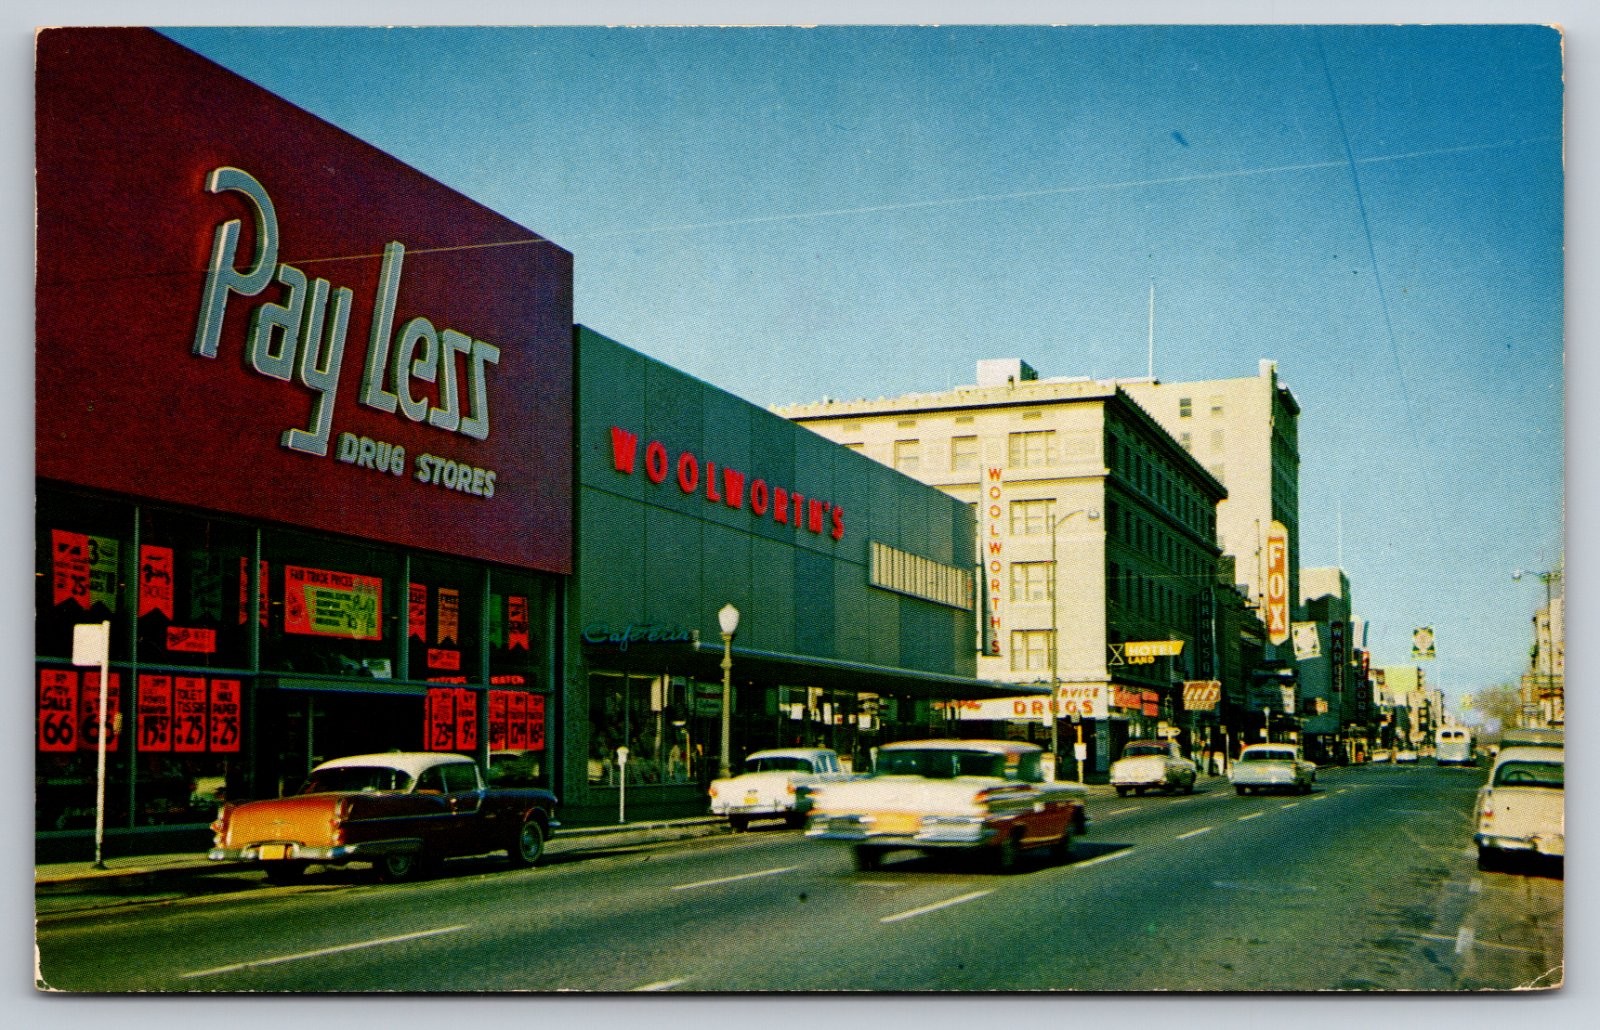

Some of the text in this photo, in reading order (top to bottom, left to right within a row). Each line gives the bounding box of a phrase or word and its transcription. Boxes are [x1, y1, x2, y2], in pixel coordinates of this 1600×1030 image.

[193, 166, 500, 456] Pay Less
[336, 432, 496, 498] DRUG STORES
[611, 426, 845, 540] WOOLWORTH'S
[1268, 544, 1286, 632] FOX
[582, 623, 689, 651] Cafeteria
[1128, 645, 1178, 656] HOTEL
[1201, 590, 1211, 675] GRAYSO
[1013, 700, 1093, 715] DRUGS
[1057, 686, 1099, 698] RVICE
[43, 713, 73, 745] 66
